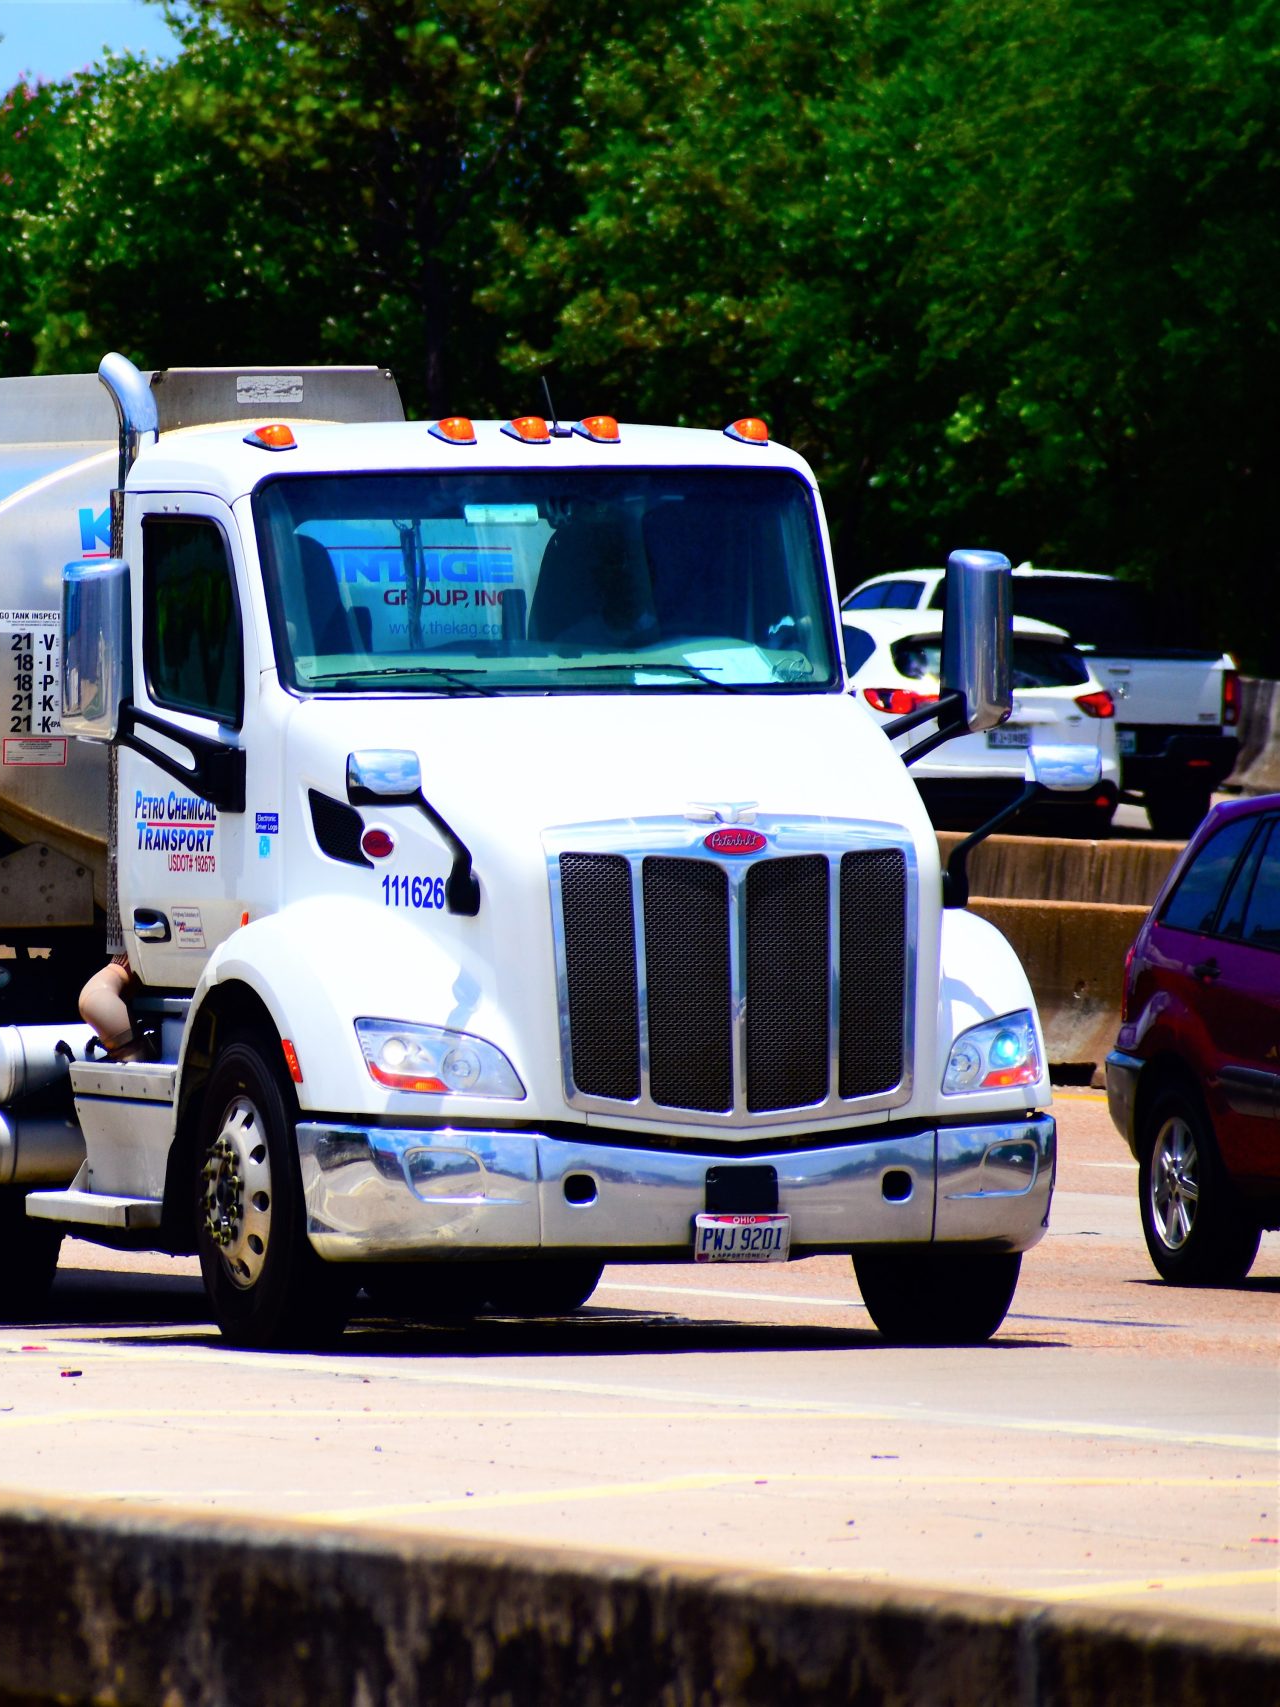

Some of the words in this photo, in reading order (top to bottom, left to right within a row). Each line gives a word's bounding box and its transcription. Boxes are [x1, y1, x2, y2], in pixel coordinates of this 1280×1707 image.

[11, 633, 31, 650] 21
[14, 654, 33, 671] 18
[14, 674, 33, 691] 18
[12, 693, 33, 711] 21
[10, 715, 31, 732] 21
[135, 790, 165, 819] PETRO
[167, 791, 216, 821] CHEMICAL
[137, 822, 214, 852] TRANSPORT
[712, 833, 759, 848] Peterbilt
[382, 874, 445, 910] 111626
[732, 1216, 756, 1224] OHIO
[702, 1228, 735, 1251] PWJ
[740, 1228, 782, 1250] 9201
